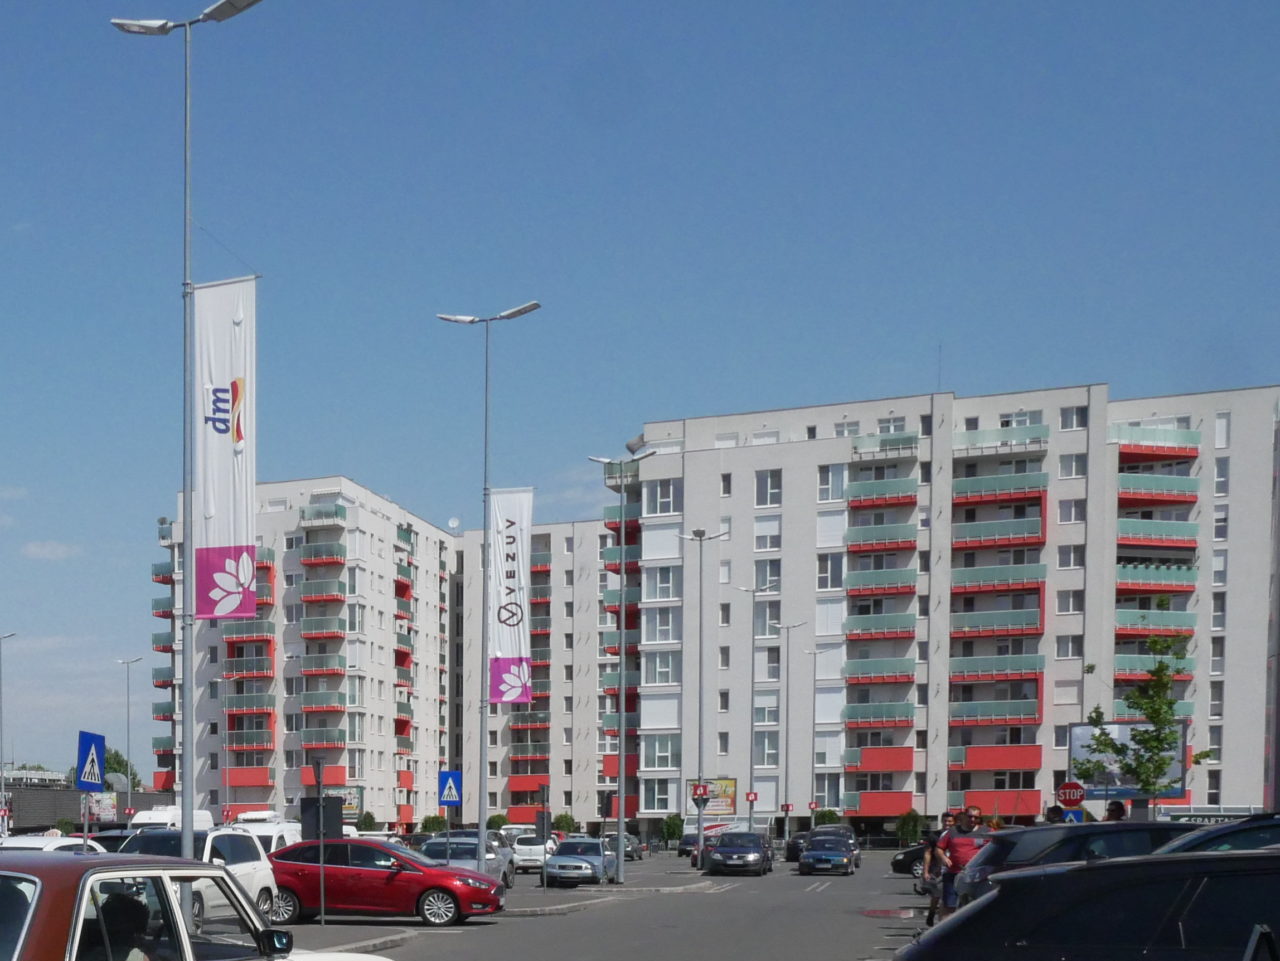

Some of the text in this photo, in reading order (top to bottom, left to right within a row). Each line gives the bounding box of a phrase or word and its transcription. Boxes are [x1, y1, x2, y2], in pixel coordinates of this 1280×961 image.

[204, 387, 231, 434] dm
[505, 519, 517, 596] VEZUV
[1058, 789, 1084, 801] STOP
